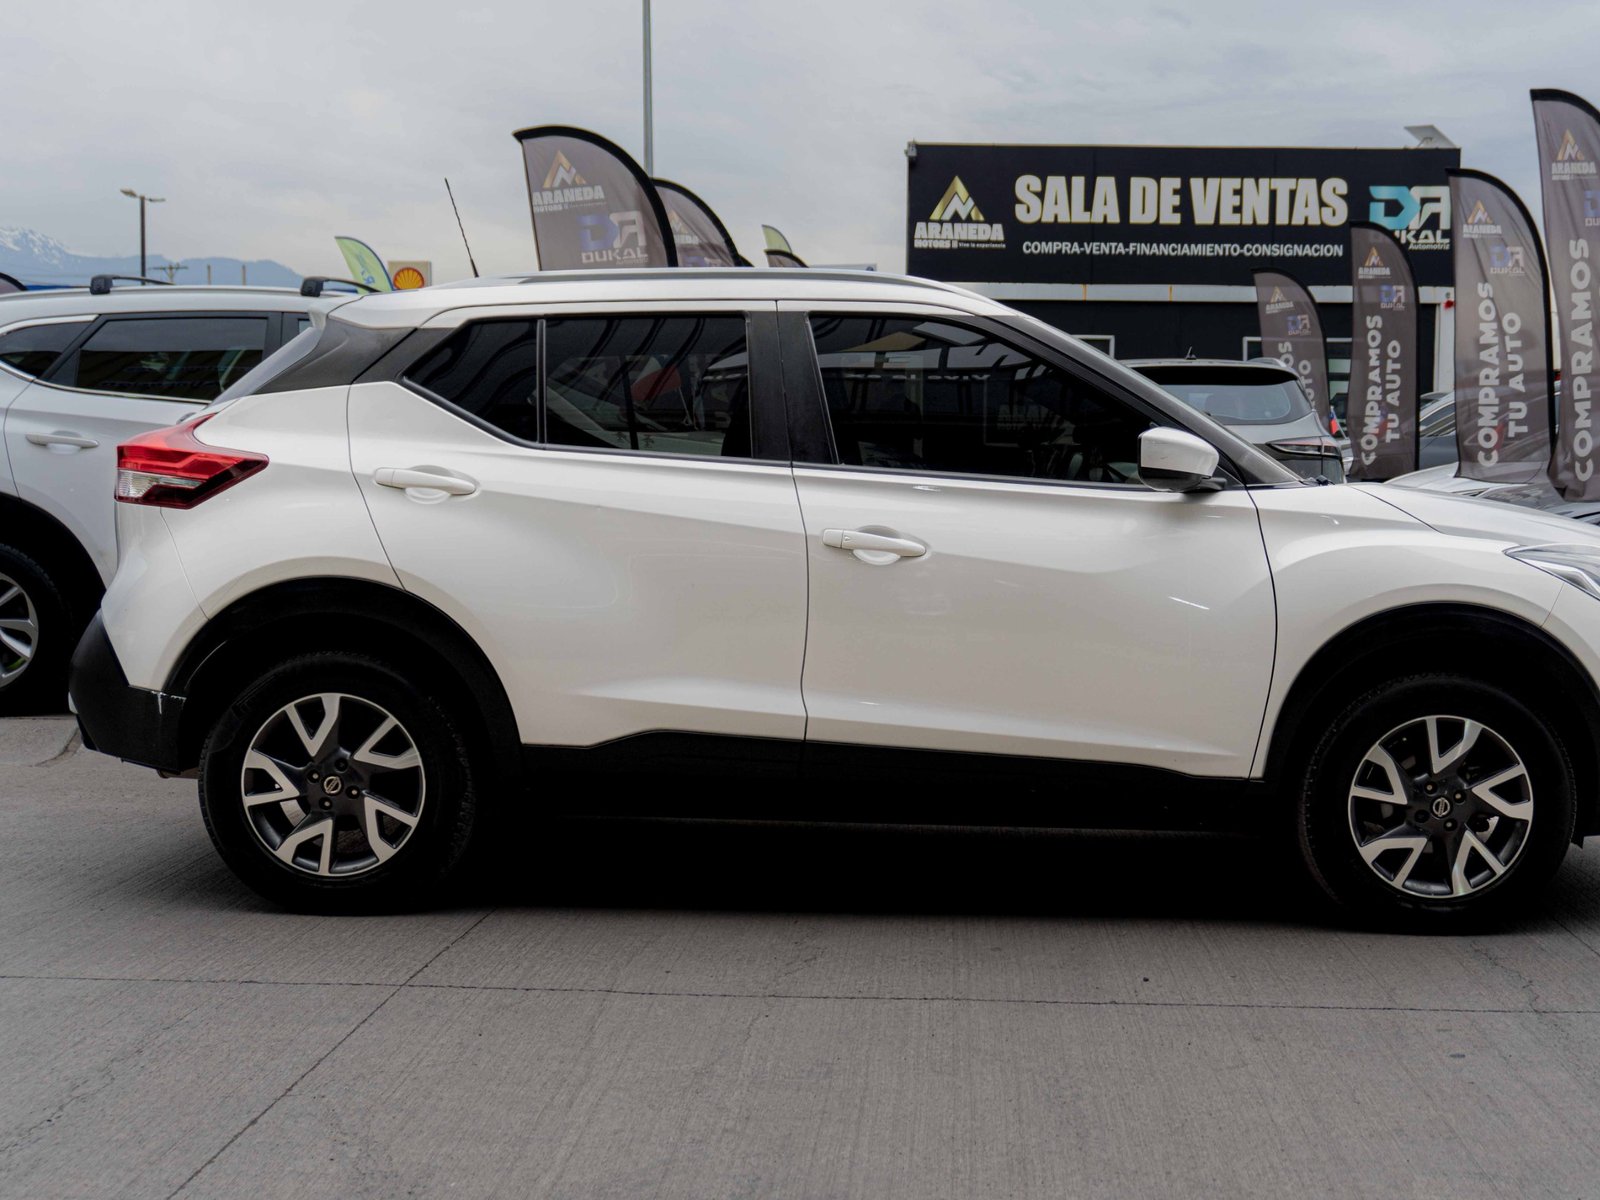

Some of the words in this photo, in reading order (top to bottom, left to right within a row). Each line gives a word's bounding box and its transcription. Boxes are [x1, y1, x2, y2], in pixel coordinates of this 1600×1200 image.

[532, 184, 606, 206] ARANEDA
[1014, 174, 1121, 225] SALA
[1128, 176, 1182, 225] DE
[1189, 176, 1349, 227] VENTAS
[913, 221, 1005, 242] ARANEDA
[913, 238, 951, 249] MOTORS
[1393, 229, 1451, 244] KAL
[580, 246, 649, 264] DUKAL
[1501, 311, 1526, 393] AUTO
[1569, 238, 1594, 482] COMPRAMOS
[1360, 314, 1384, 466] COMPRAMOS
[1385, 339, 1401, 407] AUTO
[1477, 282, 1501, 468] COMPRAMOS
[1385, 412, 1400, 444] TU
[1507, 401, 1529, 438] TU
